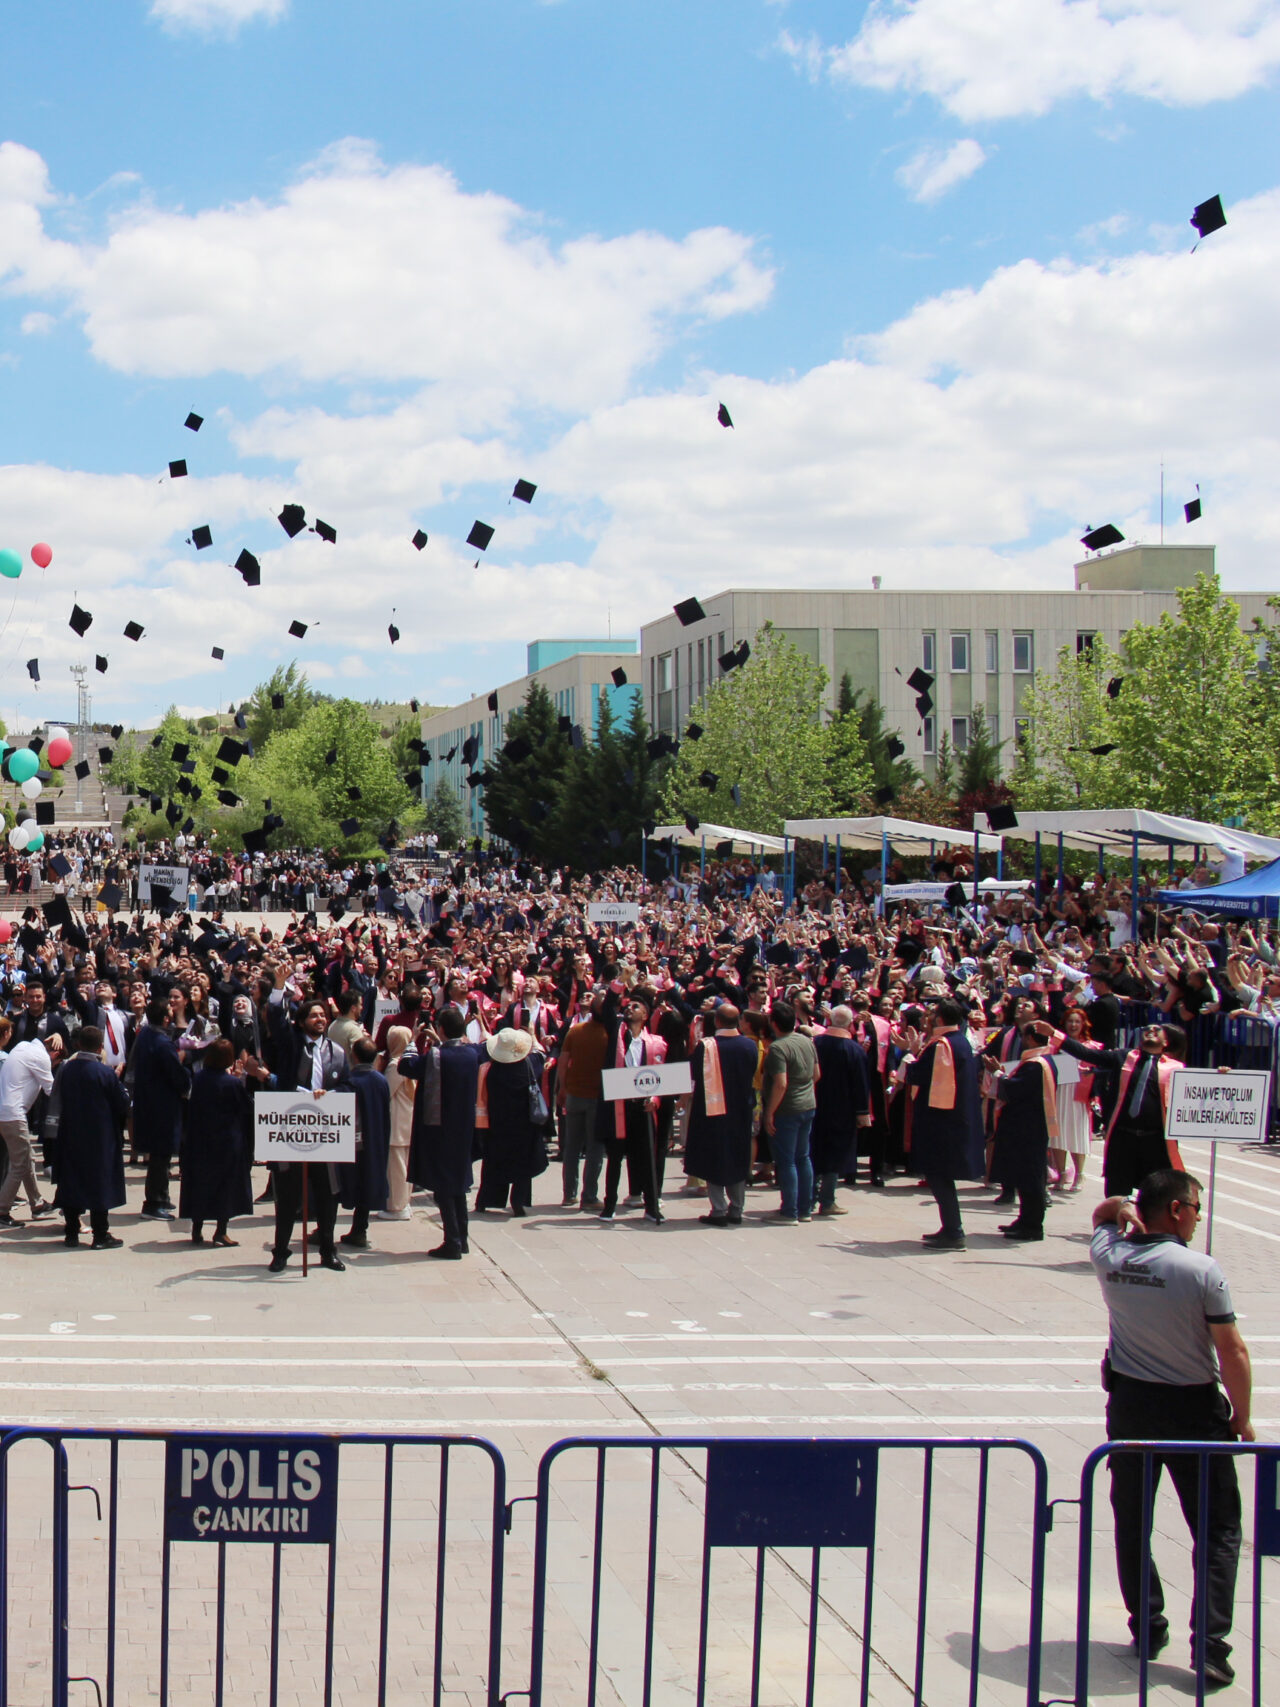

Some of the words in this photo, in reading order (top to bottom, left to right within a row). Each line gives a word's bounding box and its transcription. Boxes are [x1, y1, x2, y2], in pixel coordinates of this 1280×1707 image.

[634, 1076, 661, 1086] TARİH
[1184, 1083, 1207, 1100] İNSAN
[1209, 1087, 1220, 1100] VE
[1221, 1088, 1252, 1102] TOPLUM
[258, 1112, 351, 1126] MÜHENDİSLİK
[1176, 1106, 1214, 1123] BİLİMLERİ
[1215, 1108, 1256, 1125] FAKÜLTESİ
[268, 1130, 340, 1143] FAKÜLTESİ
[193, 1506, 308, 1536] ÇANKIRI
